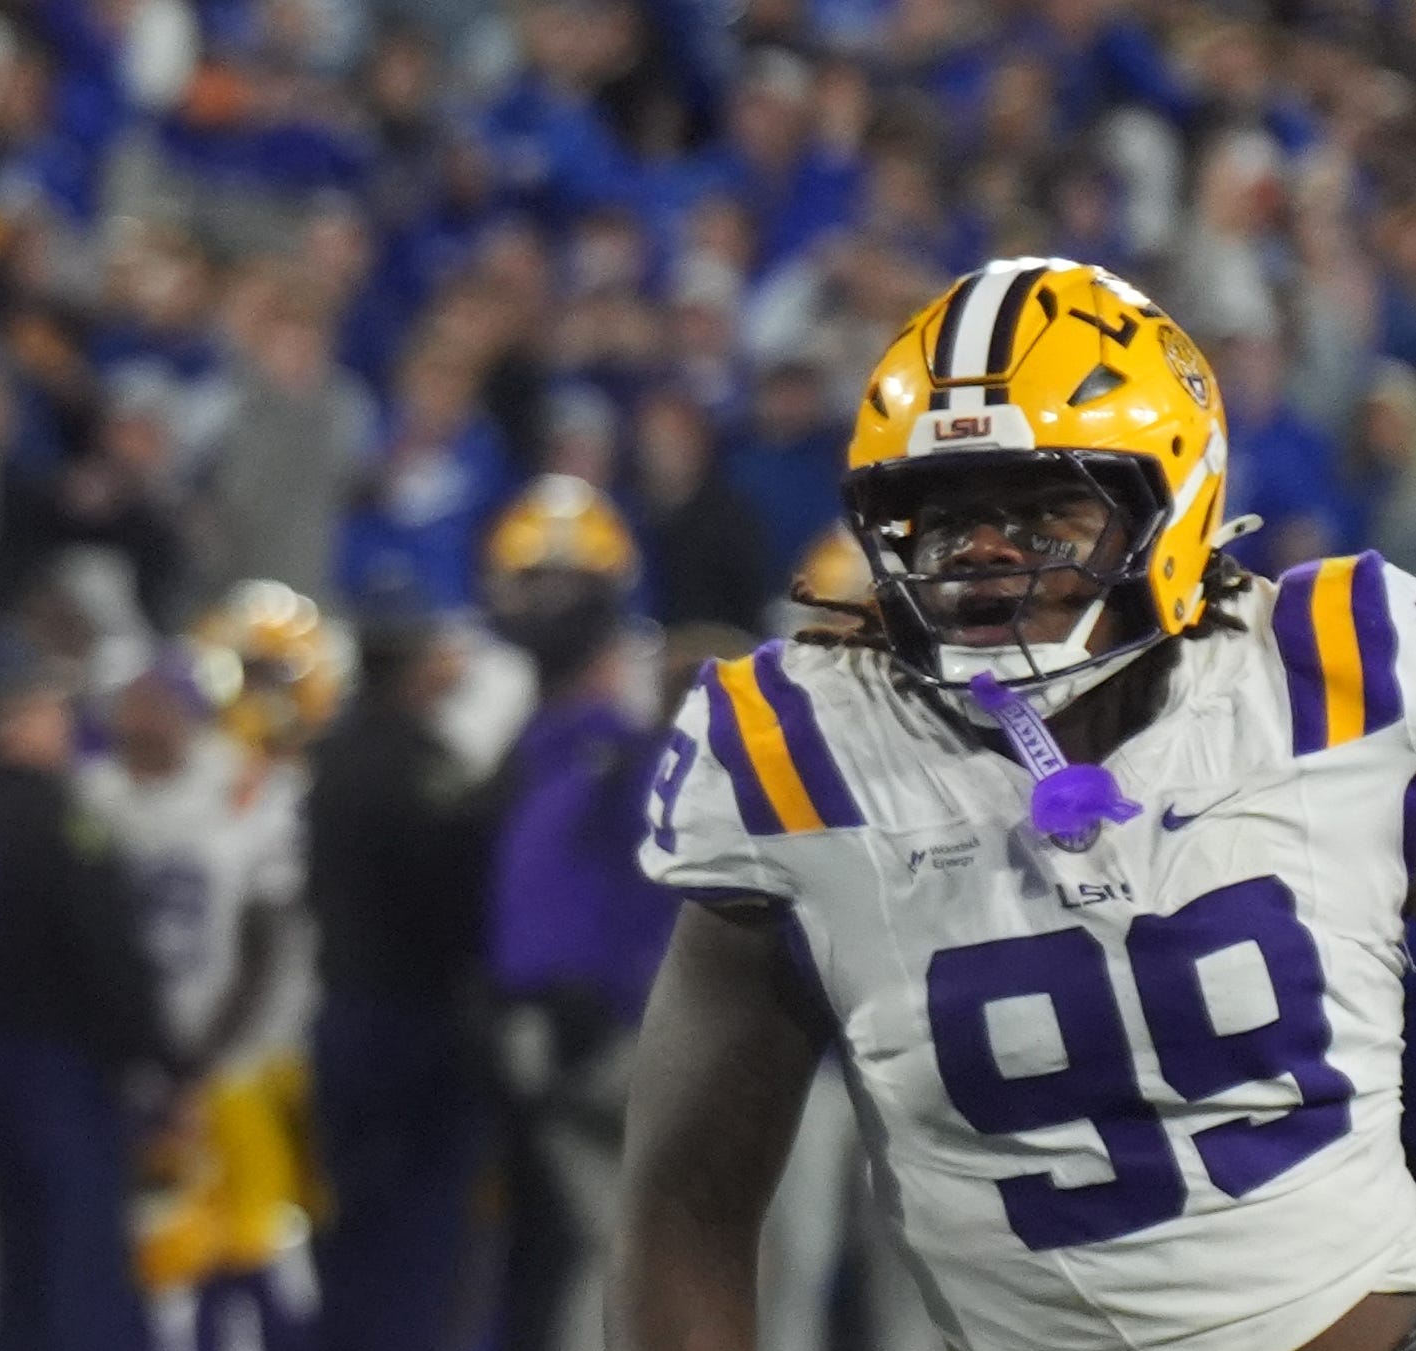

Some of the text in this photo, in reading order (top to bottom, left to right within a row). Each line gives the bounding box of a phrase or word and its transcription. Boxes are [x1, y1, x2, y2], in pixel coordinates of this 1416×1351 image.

[934, 415, 992, 440] LSU
[1055, 883, 1134, 910] LSU
[926, 873, 1357, 1253] 99
